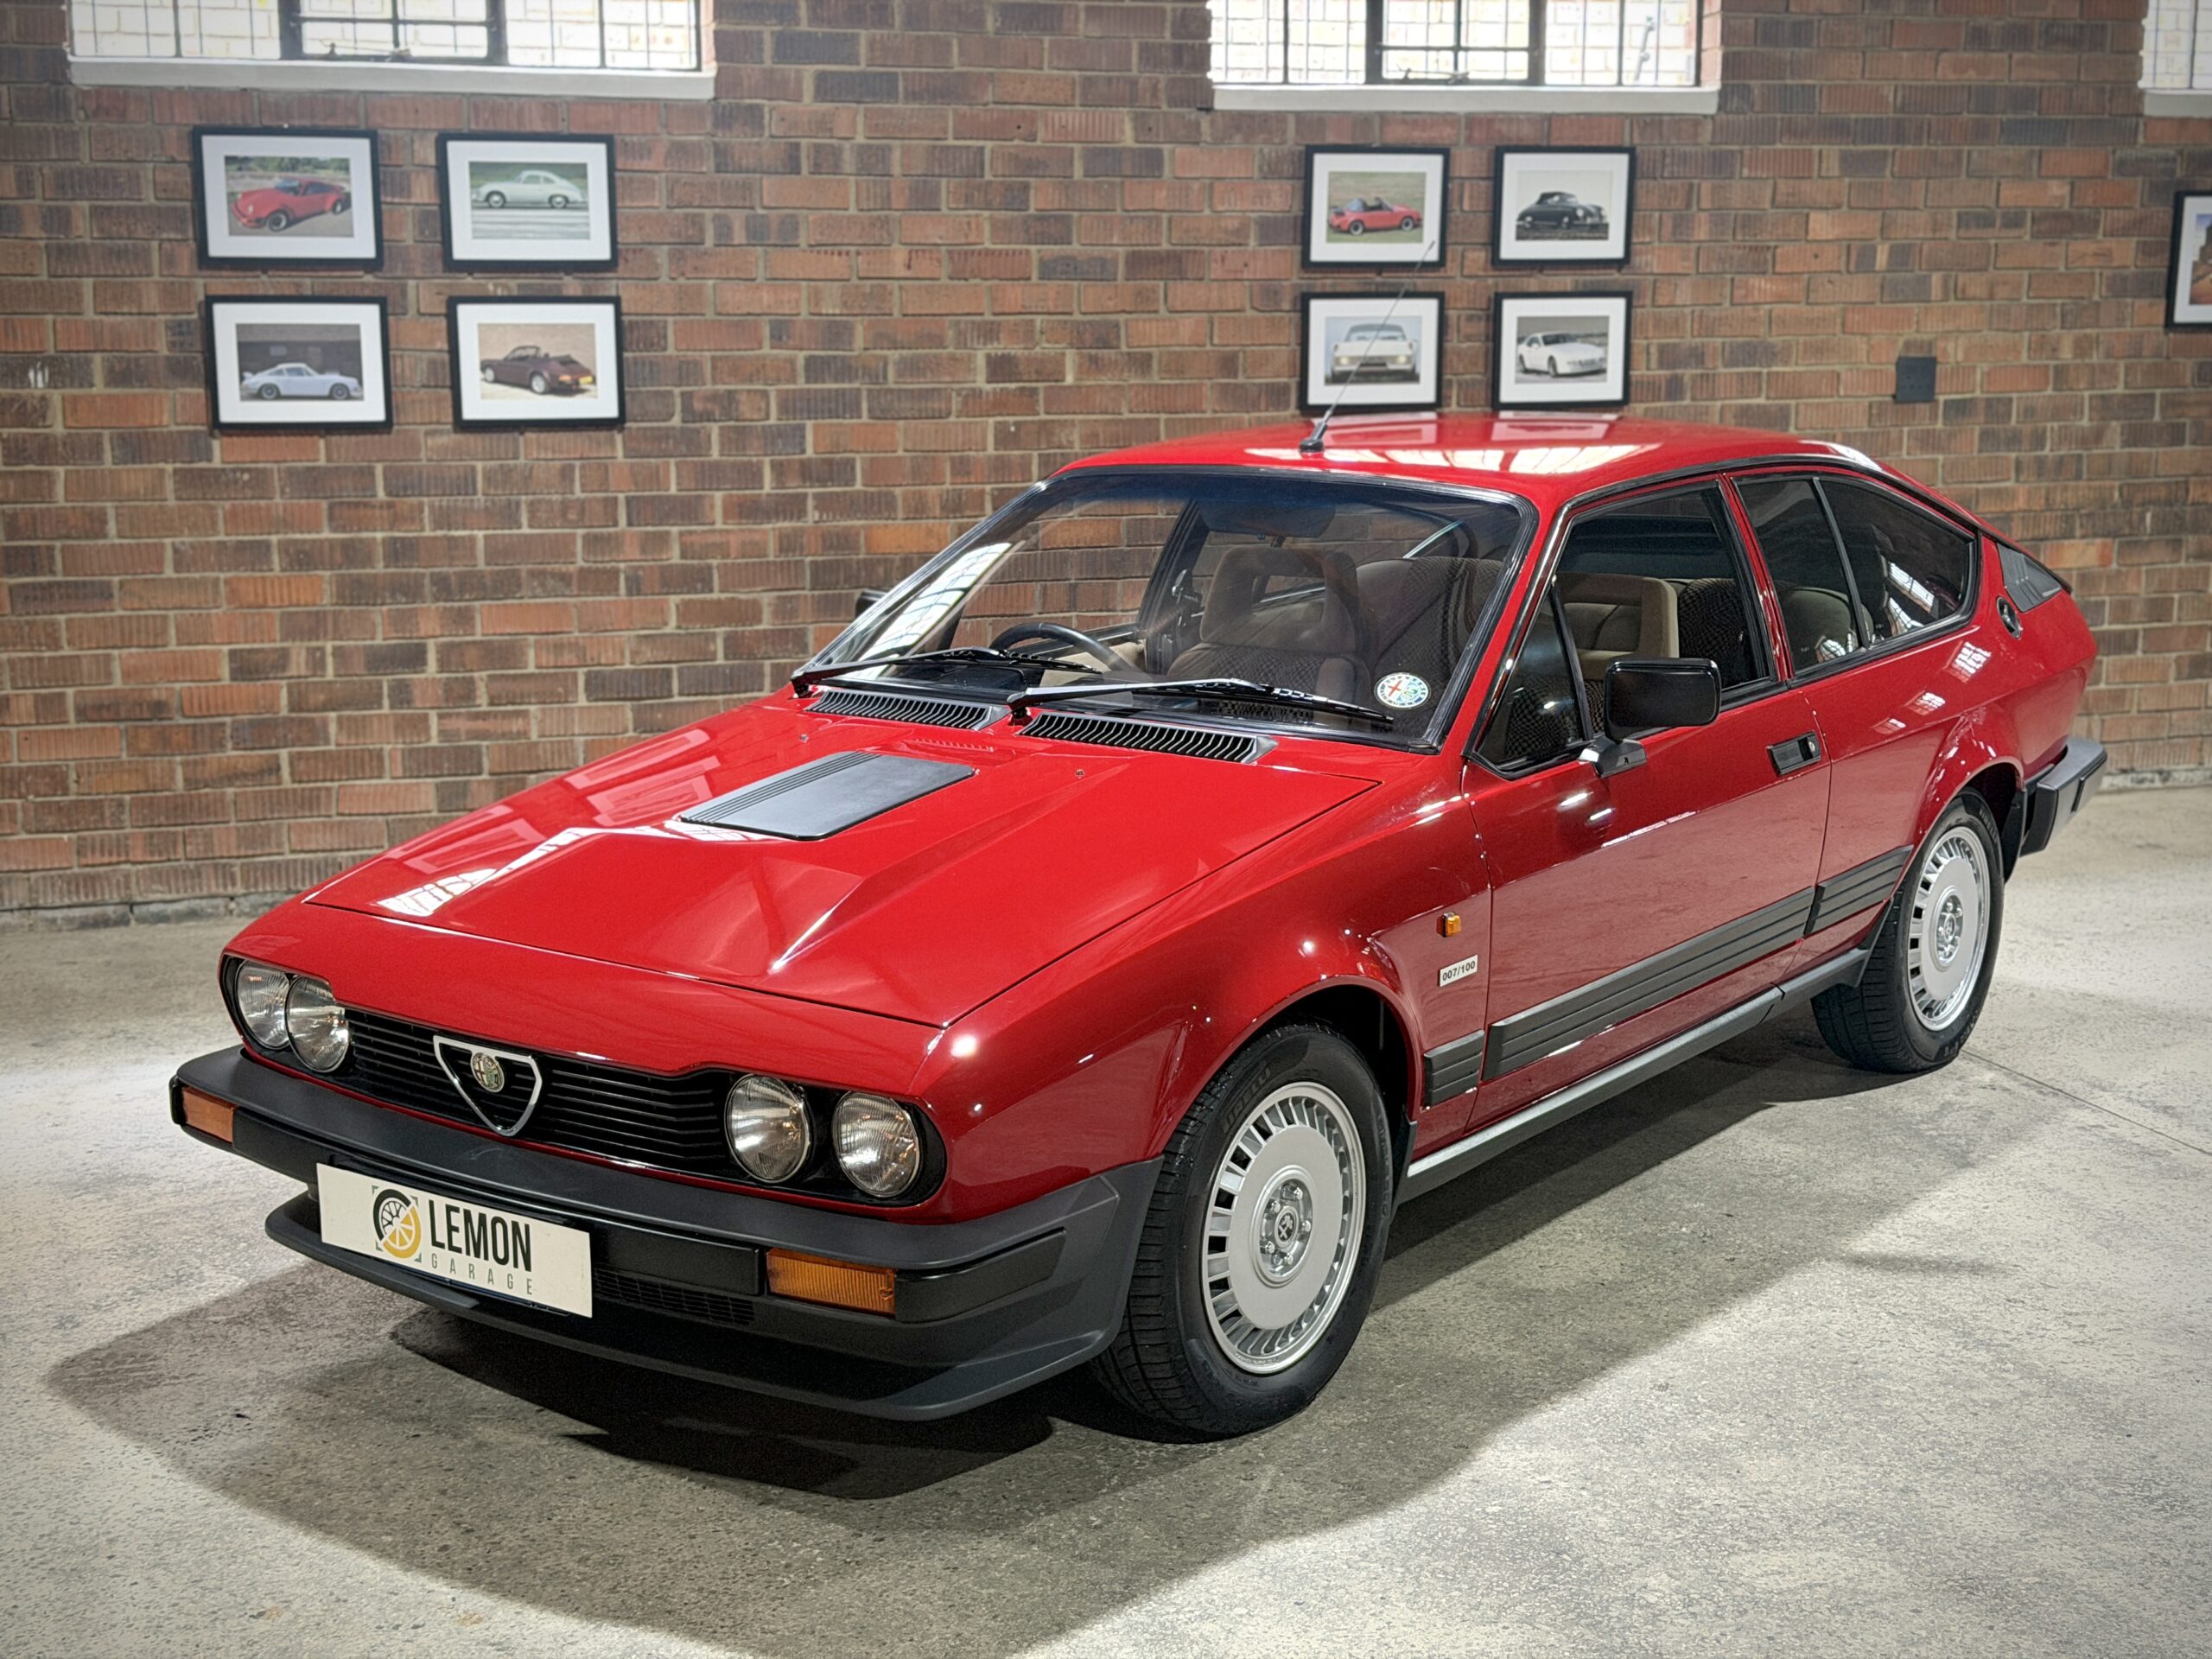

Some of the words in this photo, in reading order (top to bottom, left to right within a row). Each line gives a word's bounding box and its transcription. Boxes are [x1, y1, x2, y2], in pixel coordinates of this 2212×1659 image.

[1442, 960, 1476, 982] 007/100
[429, 1199, 532, 1273] LEMON
[431, 1253, 533, 1295] GARAGE
